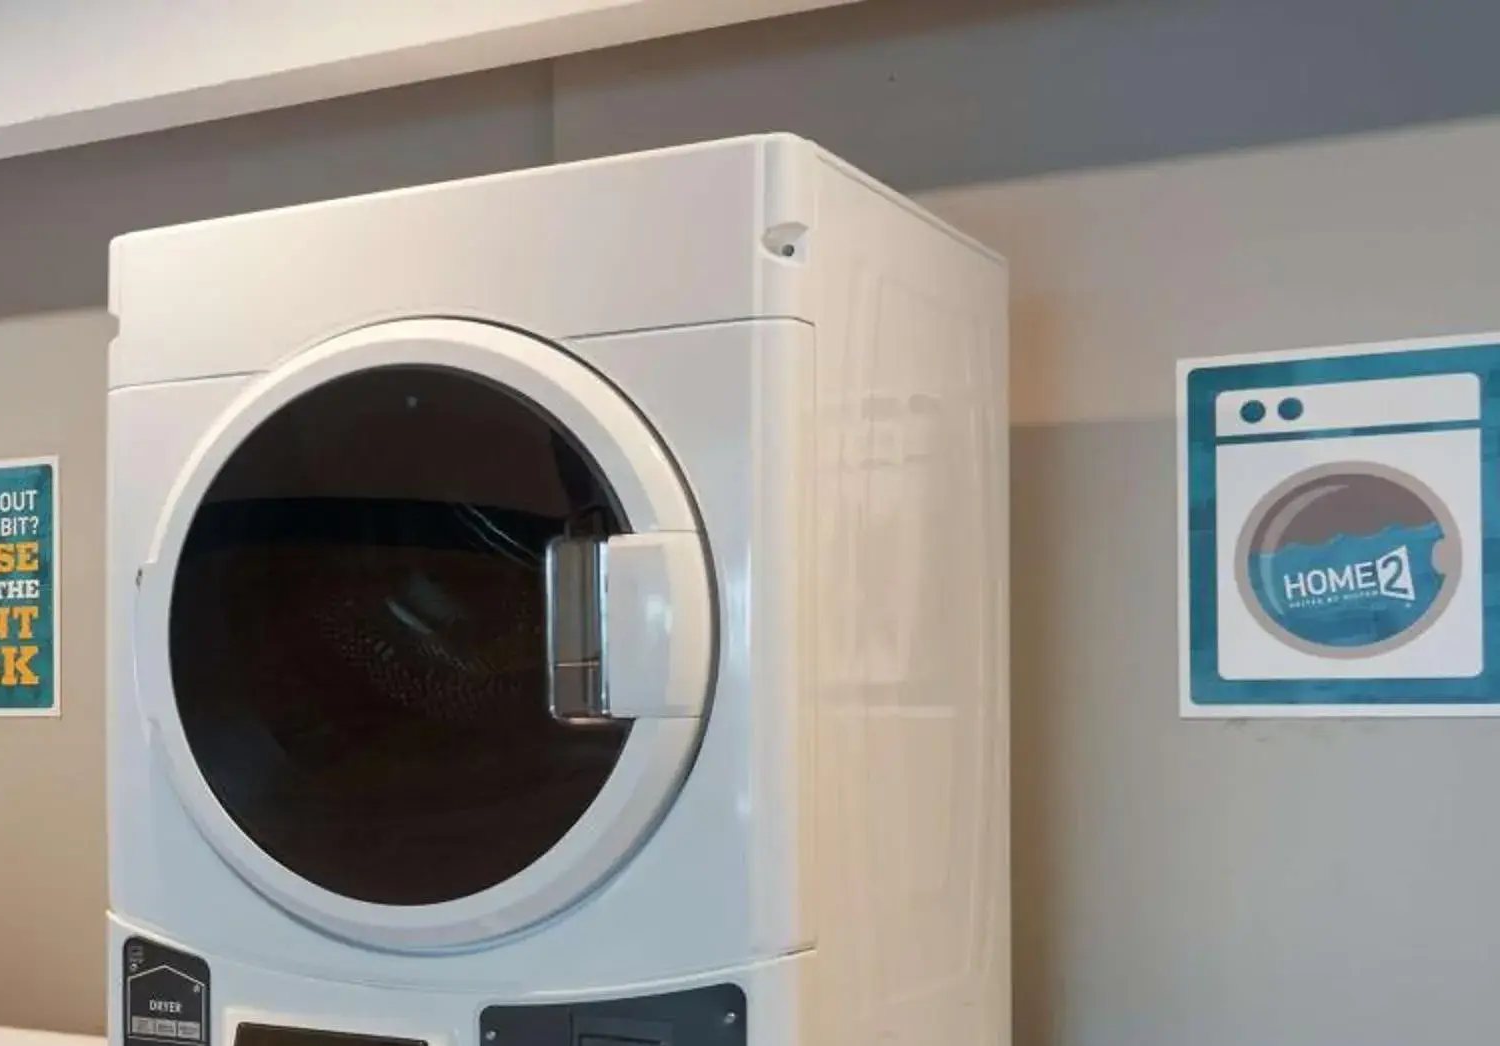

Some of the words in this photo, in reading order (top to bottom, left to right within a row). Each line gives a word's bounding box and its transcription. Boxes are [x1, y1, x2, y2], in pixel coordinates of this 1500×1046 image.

[0, 490, 38, 511] OUT
[0, 516, 39, 537] BIT?
[149, 999, 182, 1013] DRYER
